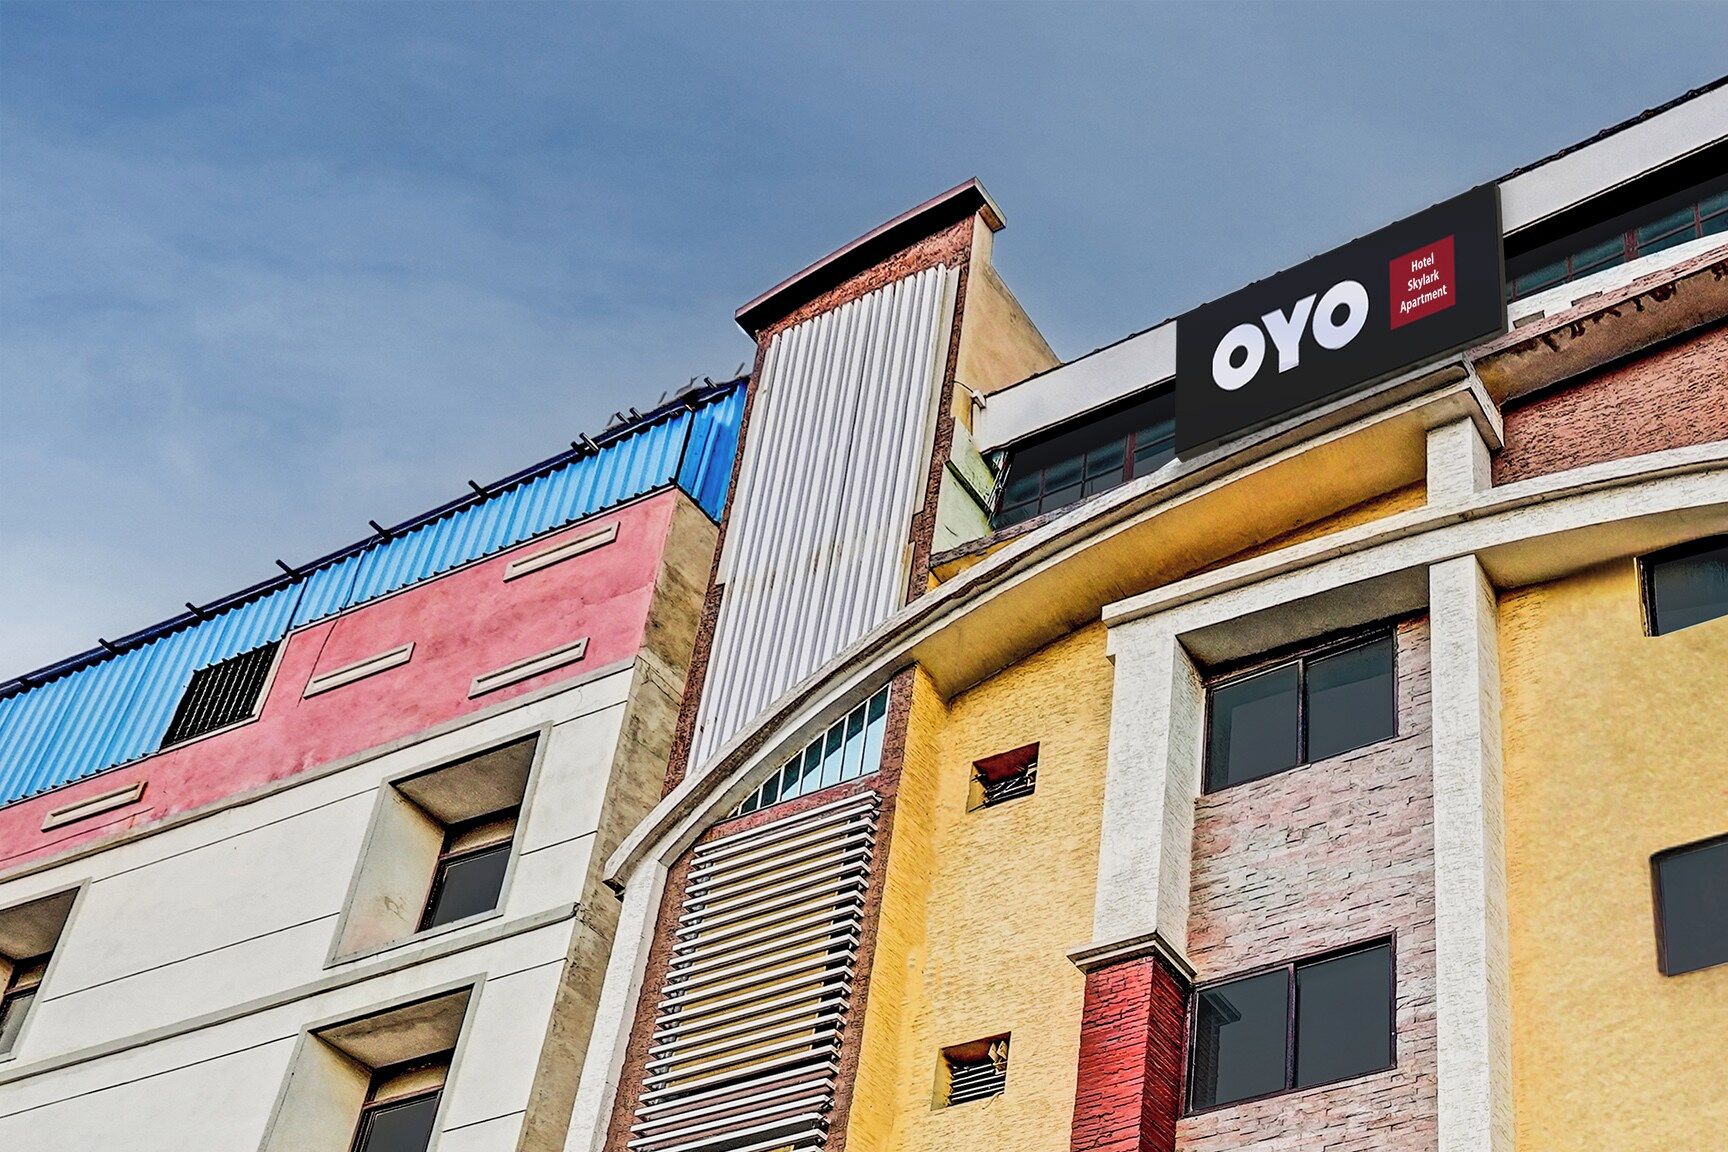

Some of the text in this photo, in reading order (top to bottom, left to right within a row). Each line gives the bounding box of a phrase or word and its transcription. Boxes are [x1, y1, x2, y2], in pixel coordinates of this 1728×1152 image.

[1411, 252, 1434, 273] Hotel
[1407, 269, 1440, 292] Skylark
[1399, 284, 1448, 314] Apartment
[1212, 280, 1369, 391] OYO
